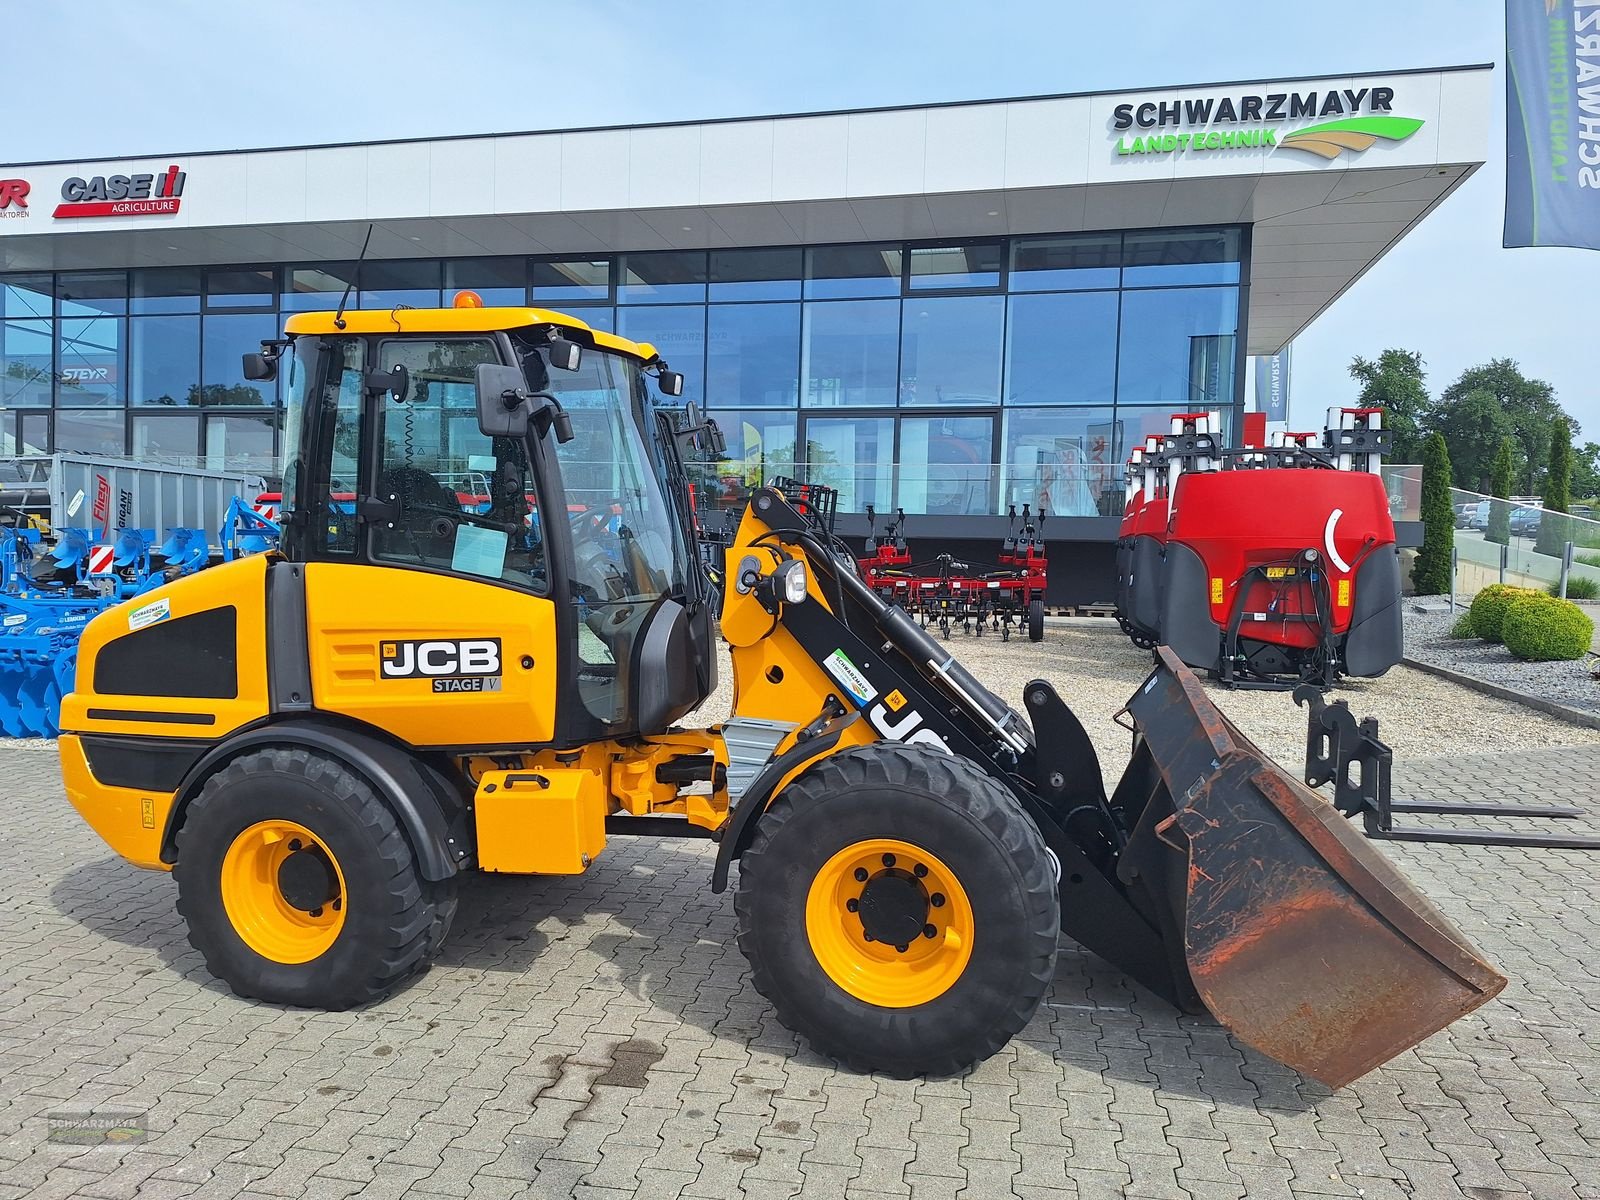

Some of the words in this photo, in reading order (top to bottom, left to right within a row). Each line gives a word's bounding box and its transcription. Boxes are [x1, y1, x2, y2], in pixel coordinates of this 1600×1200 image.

[1113, 87, 1394, 131] SCHWARZMAYR
[1117, 128, 1278, 156] LANDTECHNIK
[61, 173, 154, 202] CASE
[111, 202, 175, 213] AGRICULTURE
[61, 367, 108, 381] STEYR
[93, 473, 109, 523] Fliegl
[118, 488, 129, 528] GIGANT
[383, 641, 500, 676] JCB
[835, 656, 869, 693] SCHWARZMAYR
[434, 678, 481, 692] STAGE
[488, 678, 498, 690] V
